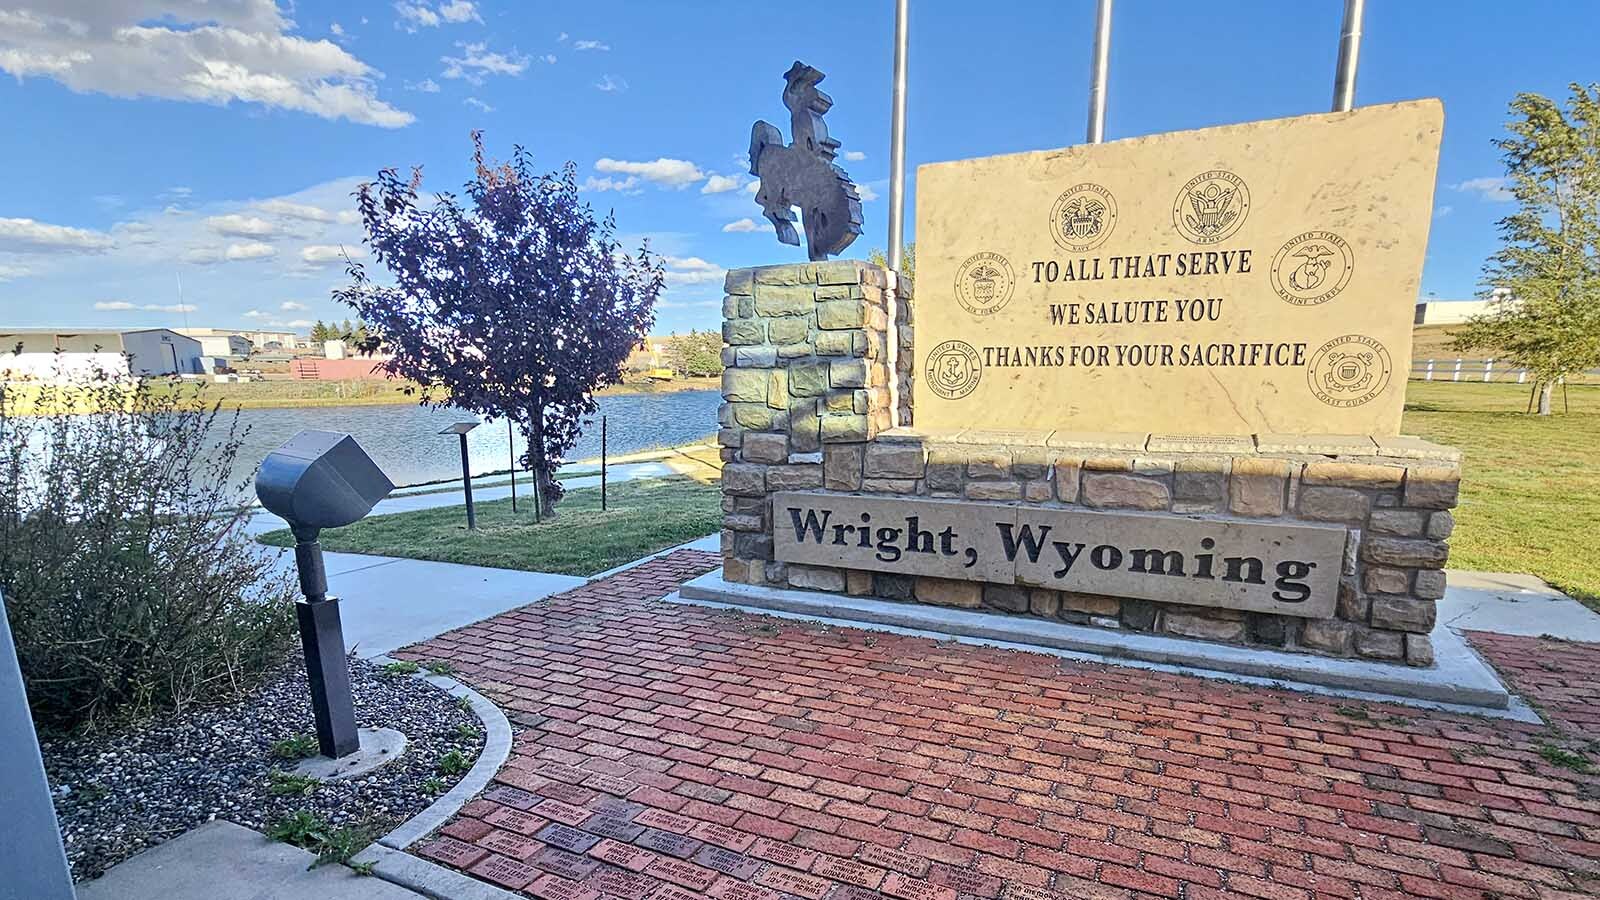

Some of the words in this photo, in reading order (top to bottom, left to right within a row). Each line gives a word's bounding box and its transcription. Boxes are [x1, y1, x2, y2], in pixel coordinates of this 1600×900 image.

[1185, 172, 1212, 191] UNITED
[1218, 172, 1242, 187] STATES
[1060, 184, 1083, 201] UNITED
[1284, 232, 1314, 250] UNITED
[1320, 232, 1347, 248] STATES
[1032, 261, 1059, 283] TO
[1063, 259, 1105, 282] ALL
[1109, 254, 1172, 280] THAT
[1175, 249, 1253, 277] SERVE
[1280, 288, 1308, 304] MARINE
[1314, 287, 1341, 304] CORPS
[1049, 303, 1080, 326] WE
[1084, 300, 1168, 325] SALUTE
[1175, 298, 1223, 322] YOU
[930, 343, 951, 361] UNITED
[956, 343, 978, 361] STATES
[1320, 336, 1352, 353] UNITED
[1358, 336, 1384, 352] STATES
[983, 345, 1065, 367] THANKS
[1069, 345, 1110, 367] FOR
[1114, 344, 1174, 367] YOUR
[1178, 342, 1307, 367] SACRIFICE
[959, 373, 979, 395] MARINE
[1316, 391, 1341, 406] COAST
[1345, 392, 1376, 407] GUARD
[787, 507, 979, 568] Wright,
[996, 522, 1318, 603] Wyoming
